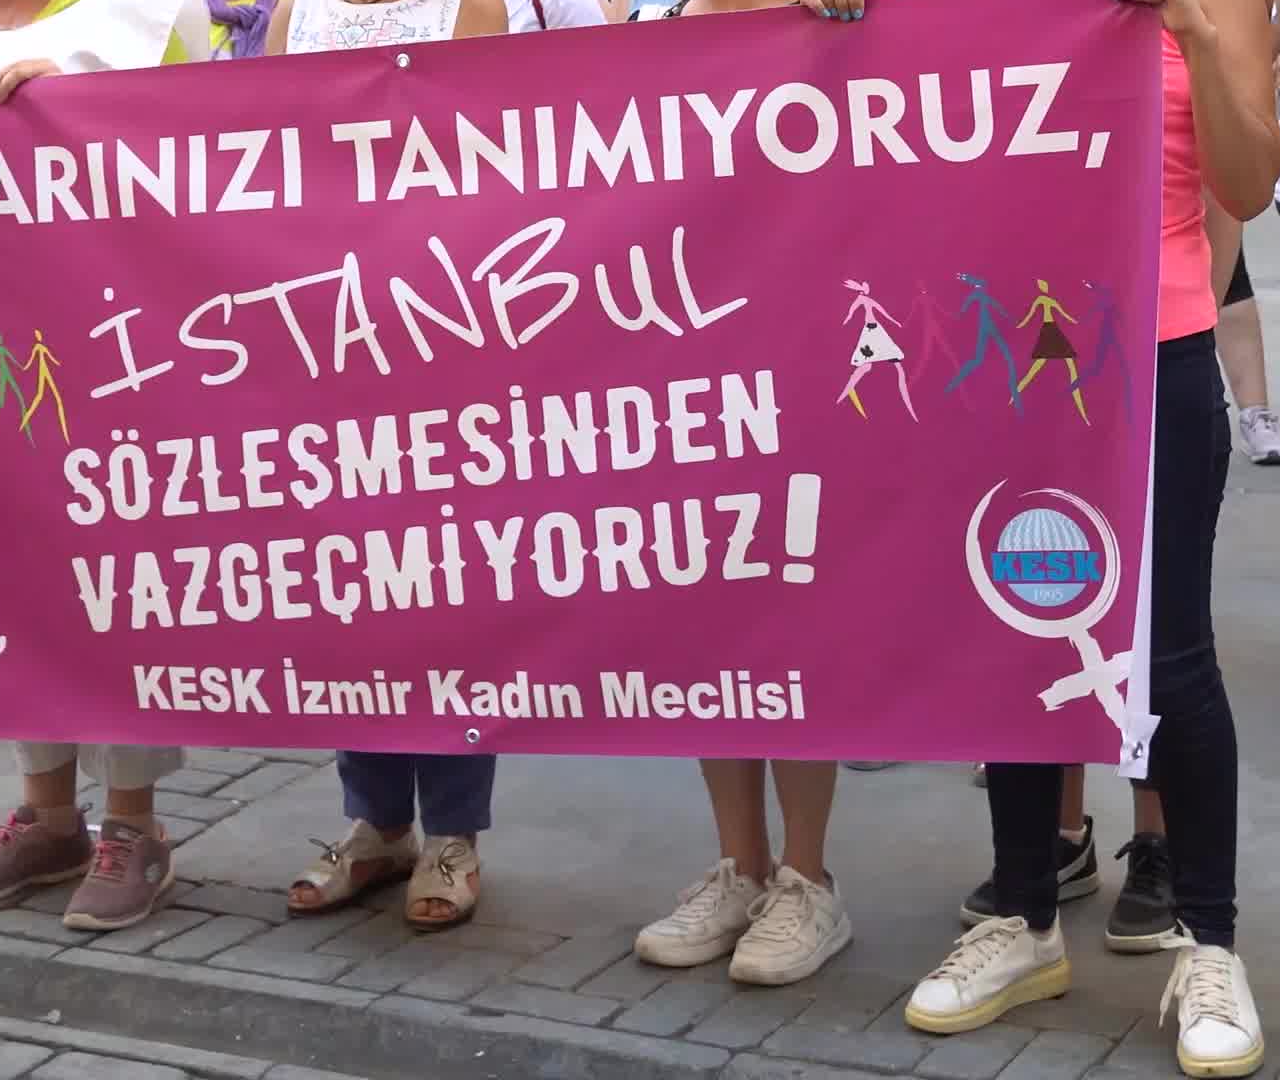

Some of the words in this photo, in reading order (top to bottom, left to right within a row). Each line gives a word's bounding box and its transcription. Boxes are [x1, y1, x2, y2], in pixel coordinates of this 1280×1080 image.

[331, 62, 1111, 203] TANIMIYORUZ,
[90, 216, 749, 399] İSTANBUL
[63, 369, 782, 526] SÖZLEŞMESİNDEN
[71, 472, 823, 632] VAZGEÇMİYORUZ!
[991, 551, 1102, 582] KESK
[132, 665, 272, 715] KESK
[282, 657, 413, 715] İzmir
[426, 669, 585, 719] Kadın
[598, 669, 806, 720] Meclisi
